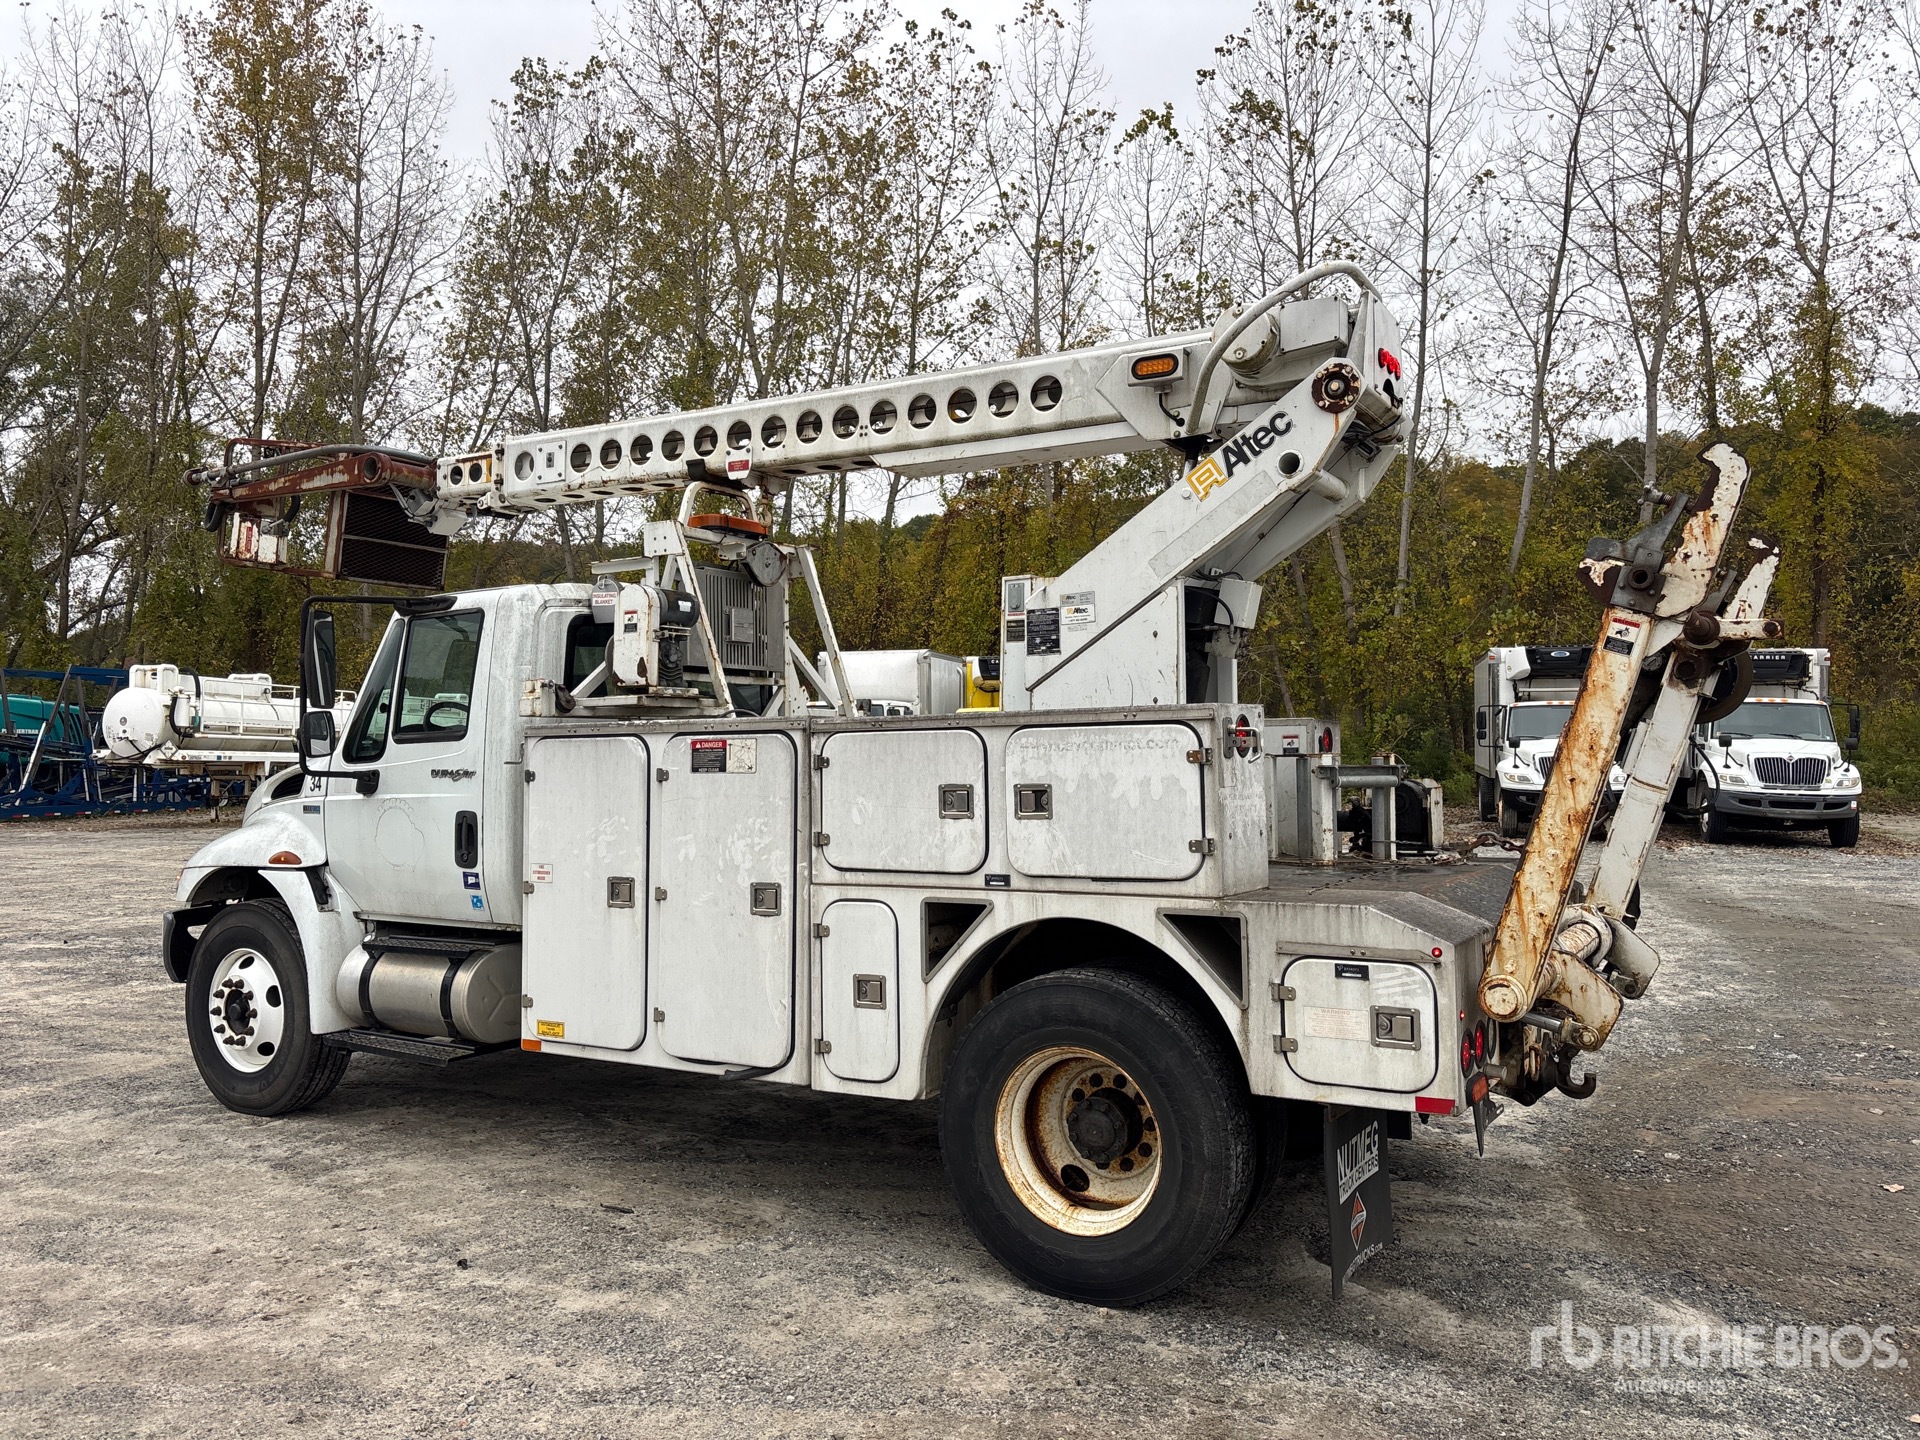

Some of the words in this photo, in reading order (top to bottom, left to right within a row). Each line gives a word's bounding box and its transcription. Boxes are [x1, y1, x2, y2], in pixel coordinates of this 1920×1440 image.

[1221, 411, 1293, 479] Altec
[1072, 606, 1089, 615] Altec
[310, 775, 322, 792] 34
[1337, 1120, 1379, 1183] NUTMEG
[1339, 1168, 1355, 1198] TRUCK
[1354, 1153, 1379, 1183] CENTERS
